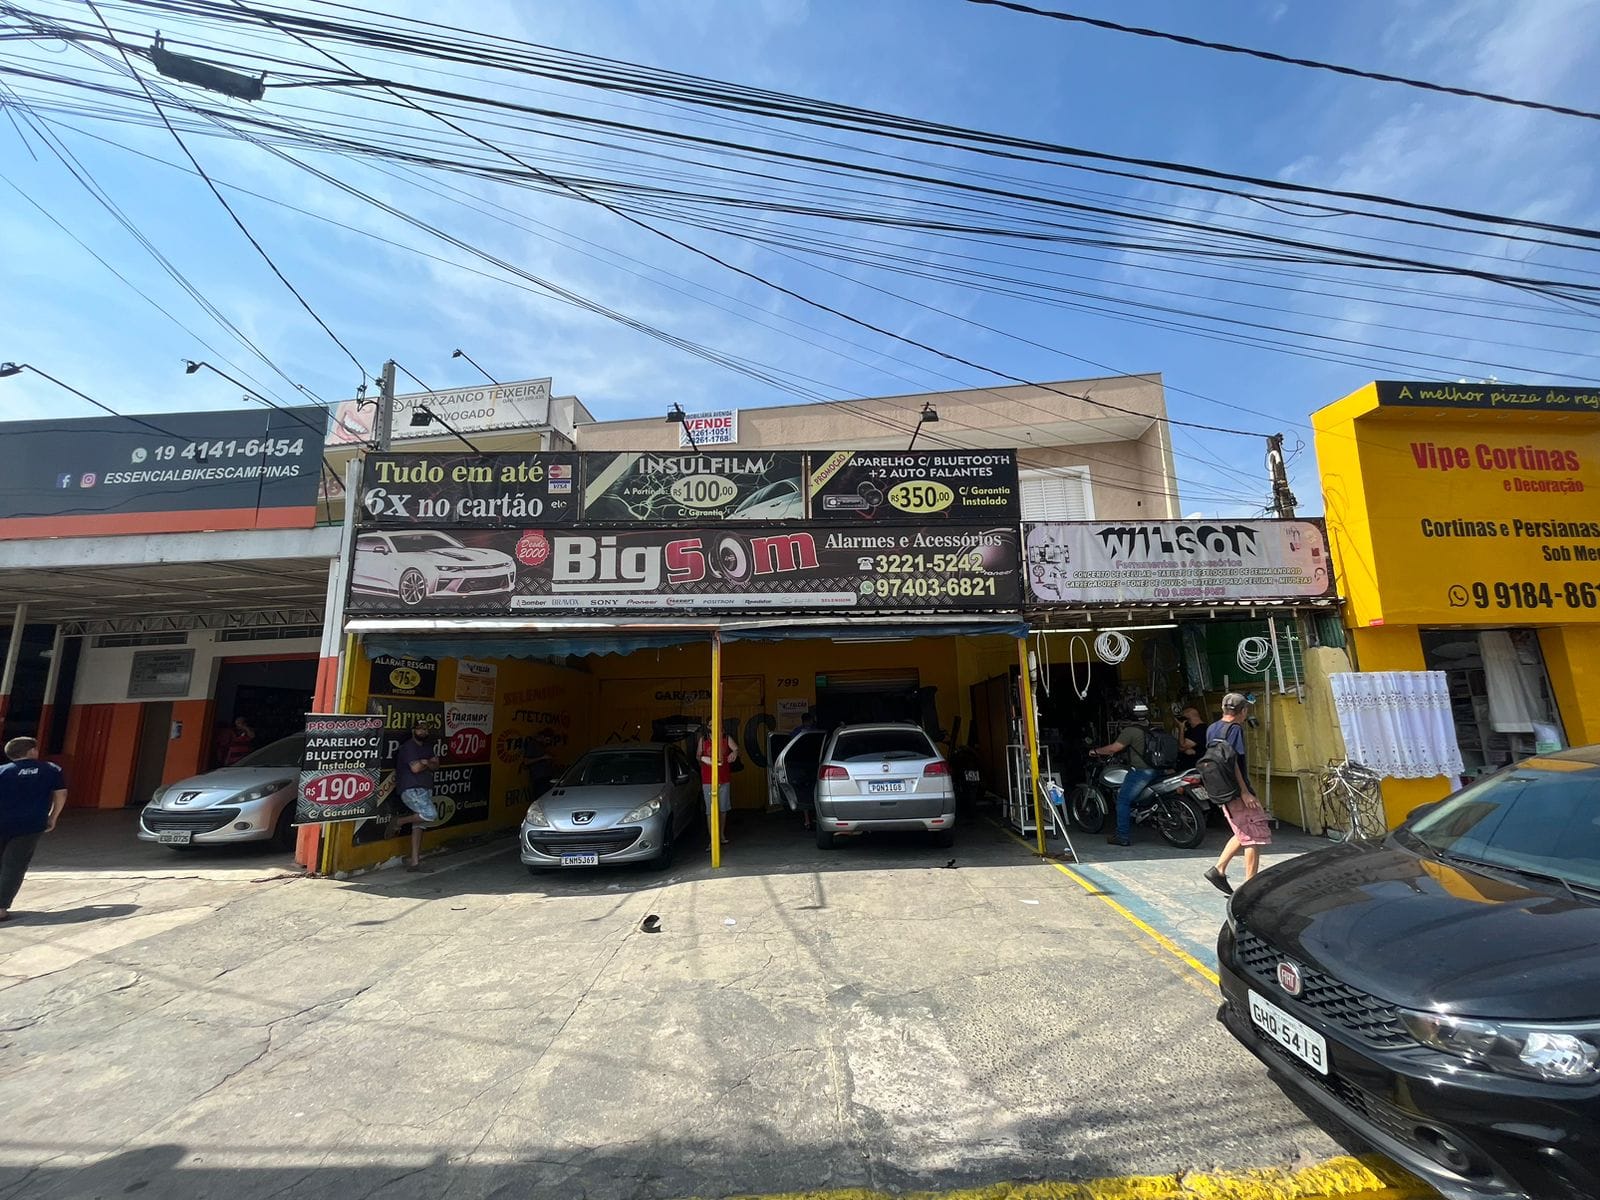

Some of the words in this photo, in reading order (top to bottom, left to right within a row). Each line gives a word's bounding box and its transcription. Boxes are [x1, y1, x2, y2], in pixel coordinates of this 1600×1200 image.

[404, 396, 437, 409] ALEX
[439, 391, 484, 406] ZANCO
[488, 384, 545, 399] TEIXEIRA
[1399, 386, 1413, 400] A
[1420, 386, 1484, 401] melhor
[1491, 388, 1541, 405] pizza
[1546, 390, 1570, 403] da
[686, 417, 732, 430] VENDE
[154, 446, 175, 461] 19
[181, 438, 304, 460] 4141-6454
[1410, 443, 1470, 471] Vipe
[1475, 443, 1581, 471] Cortinas
[640, 457, 765, 474] INSULFILM
[849, 457, 914, 466] APARELHO
[918, 456, 930, 467] C/
[934, 456, 1010, 466] BLUETOOTH
[104, 465, 300, 485] ESSENCIALBIKESCAMPINAS
[375, 460, 444, 483] Tudo
[452, 466, 493, 483] em
[500, 460, 544, 483] até
[869, 469, 887, 478] +2
[892, 468, 926, 478] AUTO
[930, 467, 993, 478] FALANTES
[959, 486, 969, 496] C/
[976, 486, 1010, 495] Garantia
[1503, 479, 1511, 491] e
[1515, 477, 1584, 495] Decoração
[417, 498, 450, 518] no
[457, 492, 543, 518] cartão
[551, 500, 567, 509] elo
[962, 496, 1007, 506] Instalado
[678, 508, 687, 516] C/
[1421, 518, 1497, 538] Cortinas
[1500, 523, 1510, 537] e
[1512, 518, 1600, 538] Persianas
[520, 540, 545, 548] Desde
[824, 532, 896, 549] Alarmes
[900, 536, 908, 548] e
[914, 531, 1002, 549] Acessórios
[1096, 525, 1260, 559] WILSON
[519, 547, 546, 558] 2000
[1542, 545, 1571, 561] Sob
[1573, 545, 1600, 561] Me
[552, 536, 662, 592] Big
[876, 554, 983, 573] 3221-5242
[877, 577, 996, 598] 97403-6821
[1472, 582, 1490, 609] 9
[1494, 582, 1600, 609] 9184-86
[375, 656, 406, 667] ALARME
[777, 678, 799, 688] 799
[307, 718, 383, 730] PROMOÇÃO
[306, 738, 366, 748] APARELHO
[369, 737, 380, 747] C/
[306, 750, 378, 761] BLUETOOTH
[318, 760, 366, 770] Instalado
[323, 807, 366, 818] Garantia
